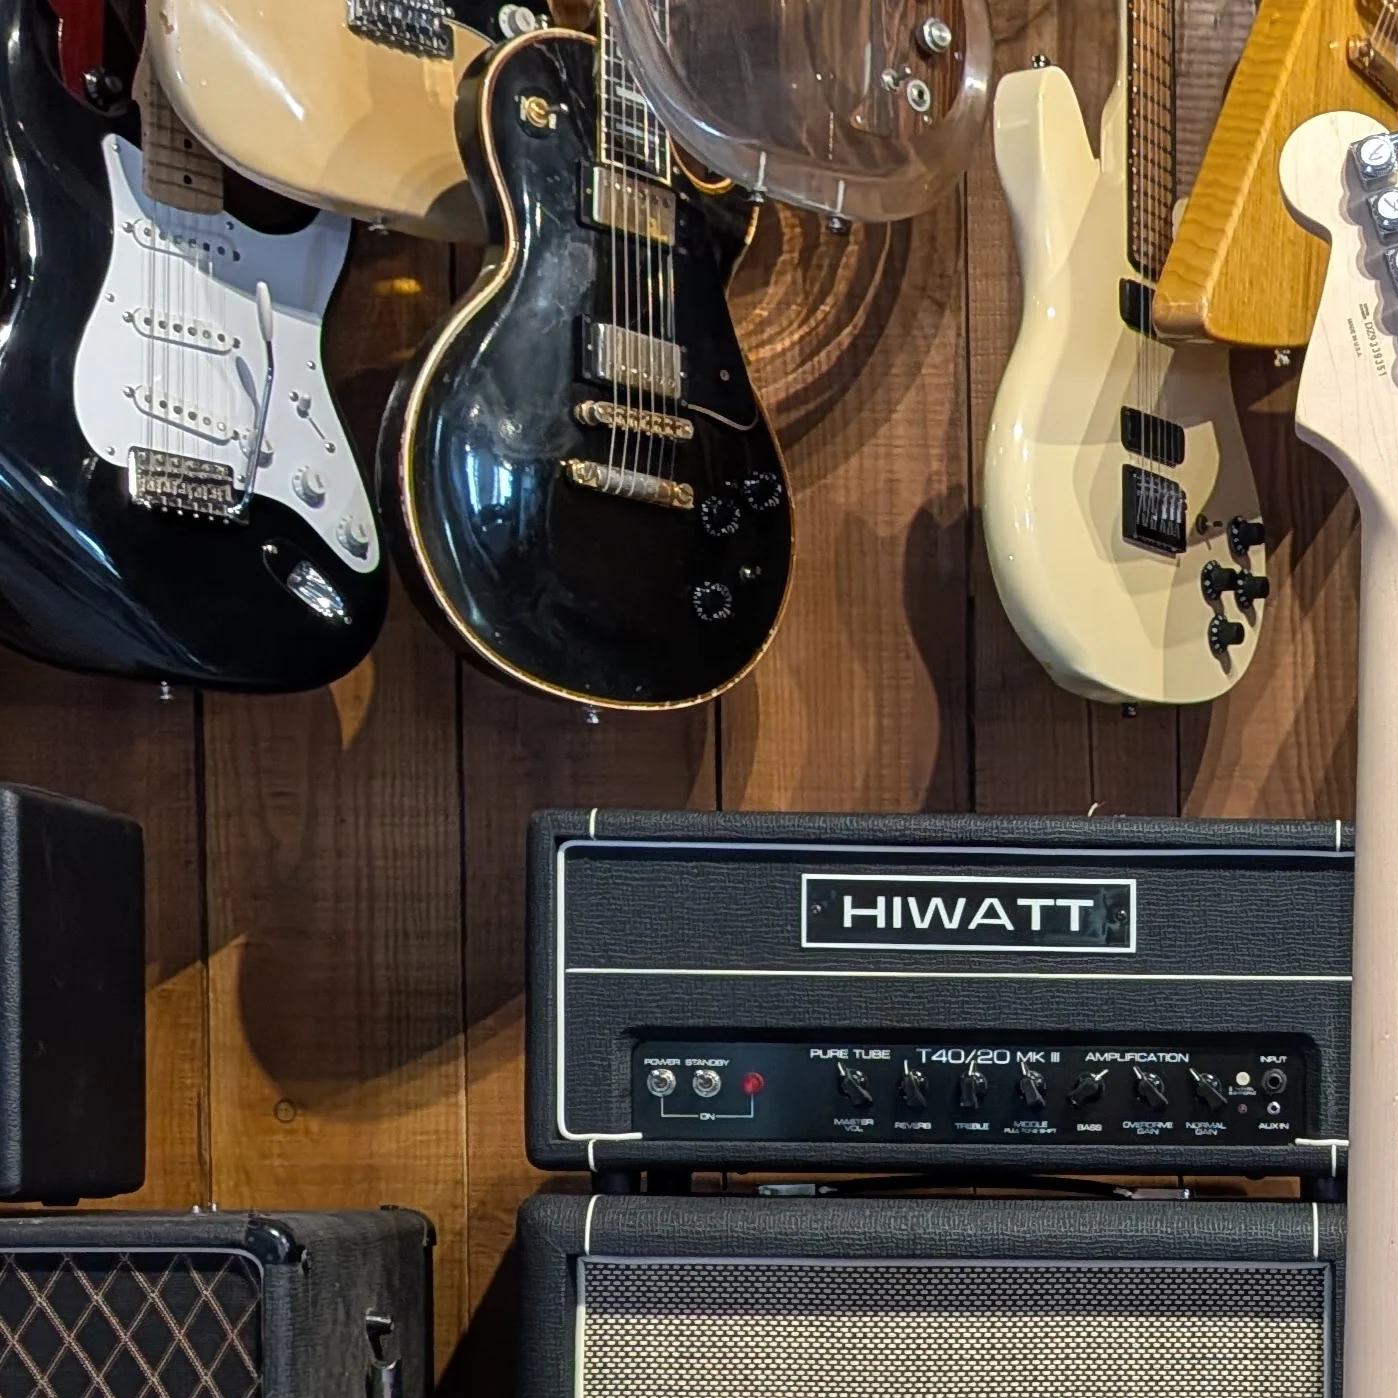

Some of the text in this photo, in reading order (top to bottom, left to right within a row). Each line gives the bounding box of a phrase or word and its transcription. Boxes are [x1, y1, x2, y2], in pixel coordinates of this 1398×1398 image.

[843, 895, 1094, 932] HIWATT
[809, 1048, 891, 1060] PURE TUBE
[915, 1048, 1011, 1065] T40/20
[1016, 1051, 1046, 1063] MK
[1085, 1052, 1190, 1063] AMPLIFICATION
[643, 1058, 730, 1067] POWER STANDBY
[1260, 1055, 1288, 1063] INPUT
[699, 1112, 716, 1121] ON
[833, 1118, 875, 1126] MASTER
[894, 1122, 932, 1130] REVERB
[954, 1122, 990, 1130] TREBLE
[1013, 1120, 1048, 1128] MIDDLE
[1122, 1121, 1174, 1129] OVERDRIVE
[1185, 1121, 1227, 1130] NORMAL
[1258, 1122, 1278, 1130] AUX
[1076, 1123, 1103, 1131] BASS
[1194, 1128, 1218, 1136] GAIN
